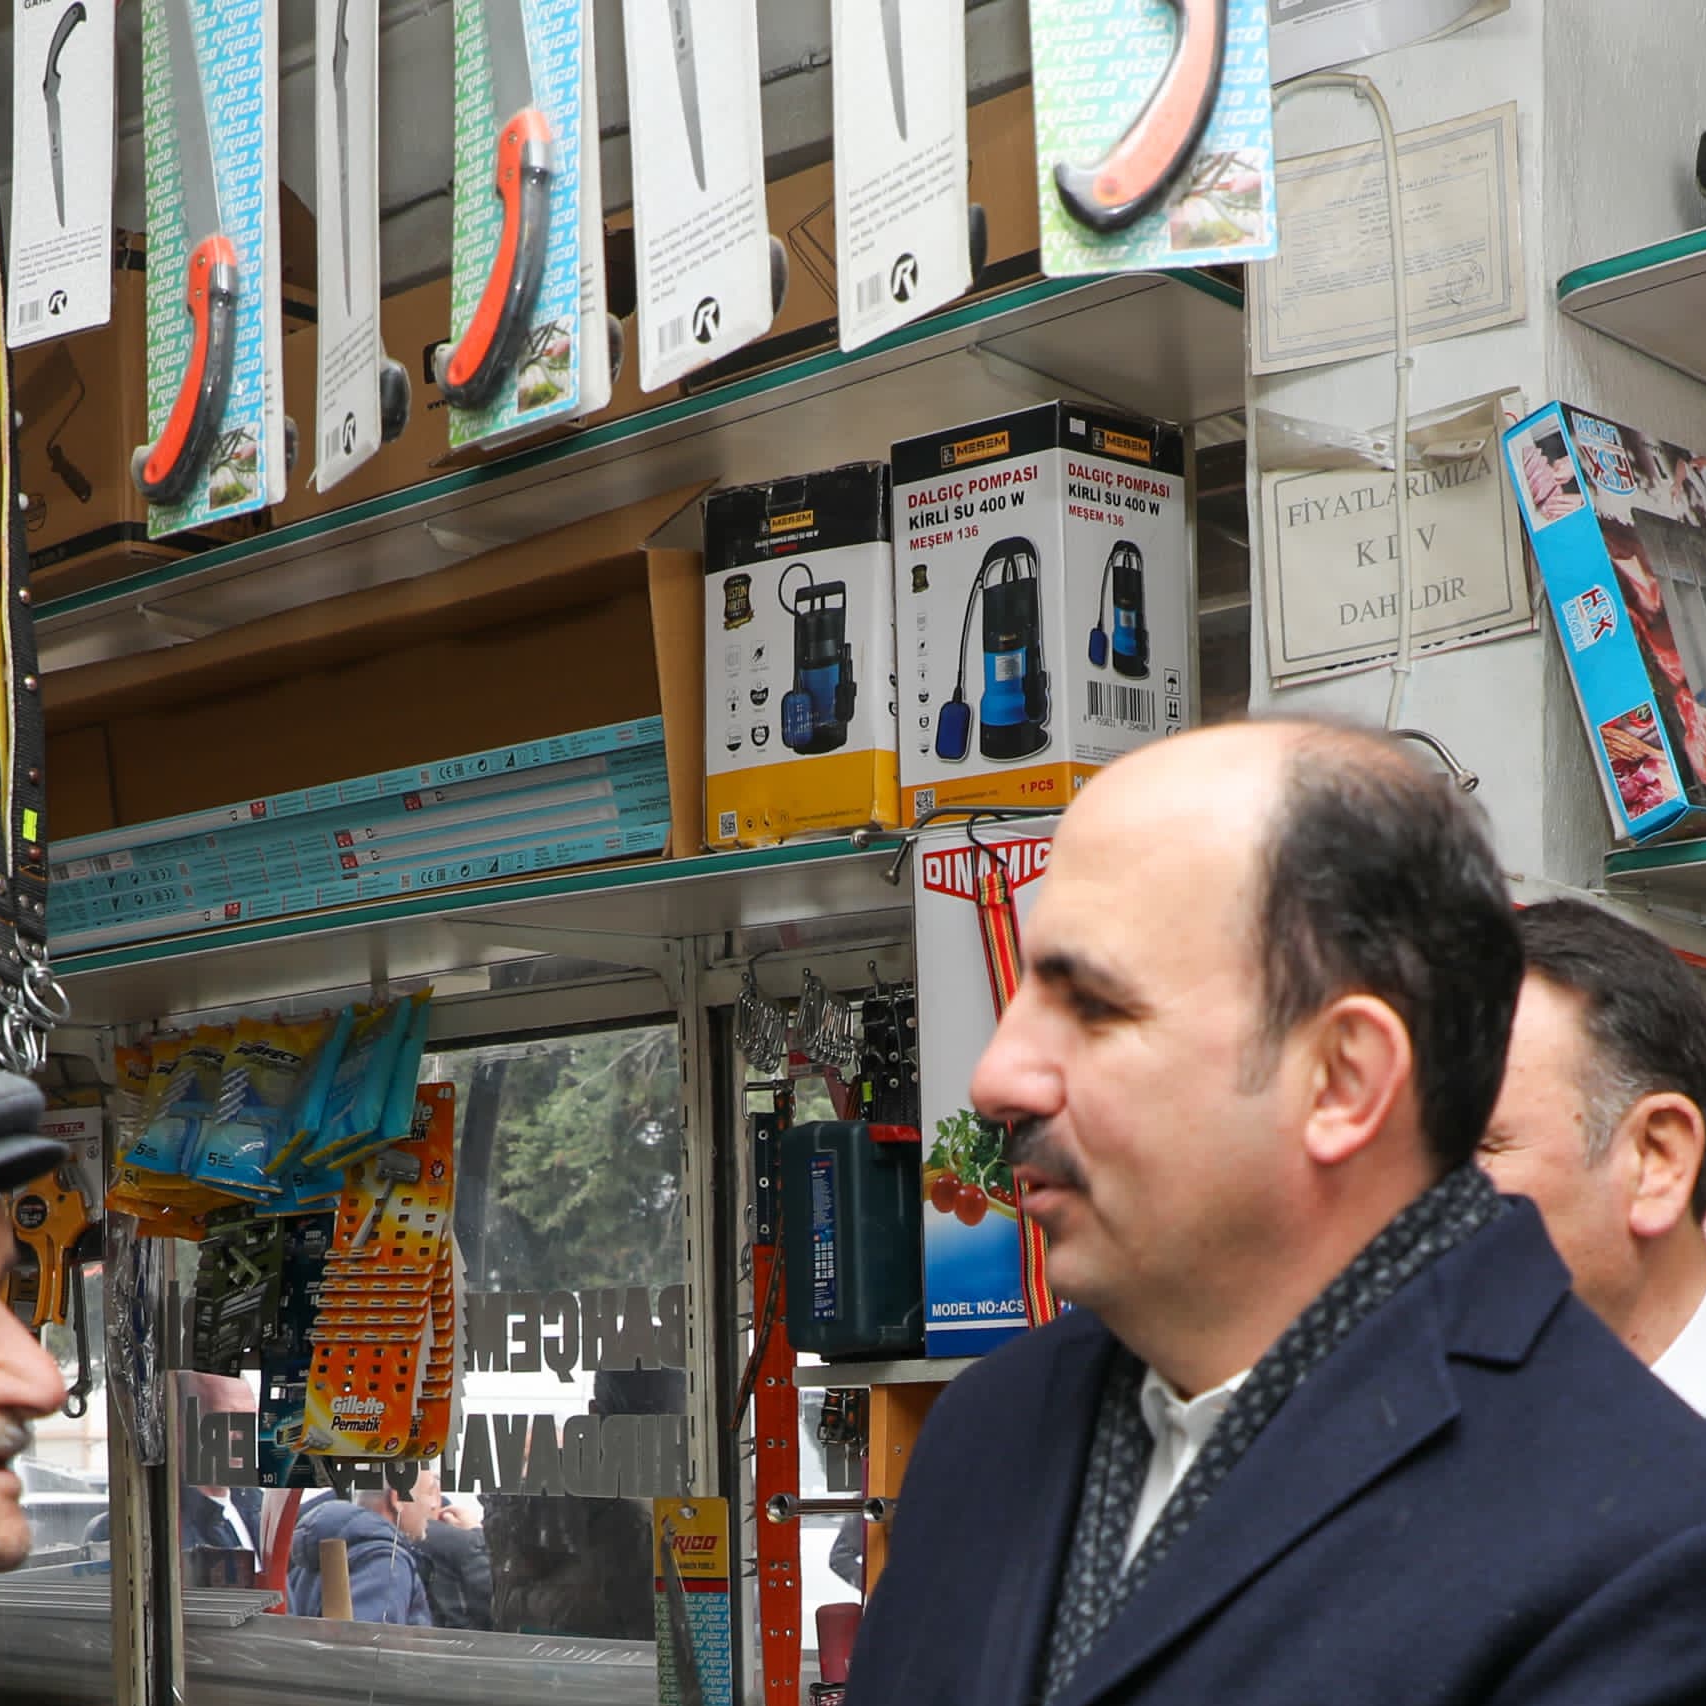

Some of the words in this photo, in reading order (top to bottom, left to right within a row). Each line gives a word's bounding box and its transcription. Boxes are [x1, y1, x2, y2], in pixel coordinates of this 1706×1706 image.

[907, 483, 965, 509] DALGIÇ
[968, 465, 1039, 495] POMPASI
[1067, 462, 1113, 489] DALGIÇ
[1116, 477, 1171, 499] POMPASI
[909, 505, 950, 530] KİRLİ
[953, 502, 975, 521] SU
[980, 495, 1007, 514] 400
[1010, 490, 1025, 506] W
[1068, 482, 1101, 504] KİRLİ
[1104, 491, 1121, 508] SU
[1125, 496, 1146, 513] 400
[1148, 502, 1160, 517] W
[1068, 505, 1104, 523] MEŞEM
[1106, 512, 1125, 528] 136
[909, 531, 954, 551] MEŞEM
[957, 524, 980, 541] 136
[1340, 576, 1471, 626] DAHLDİR
[1029, 778, 1055, 793] PCS
[207, 1152, 219, 1167] 5
[932, 1303, 975, 1318] MODEL
[977, 1300, 1026, 1317] NO:ACS
[330, 1396, 386, 1416] Gillette
[330, 1416, 381, 1433] Permatik
[672, 1534, 719, 1553] RICO
